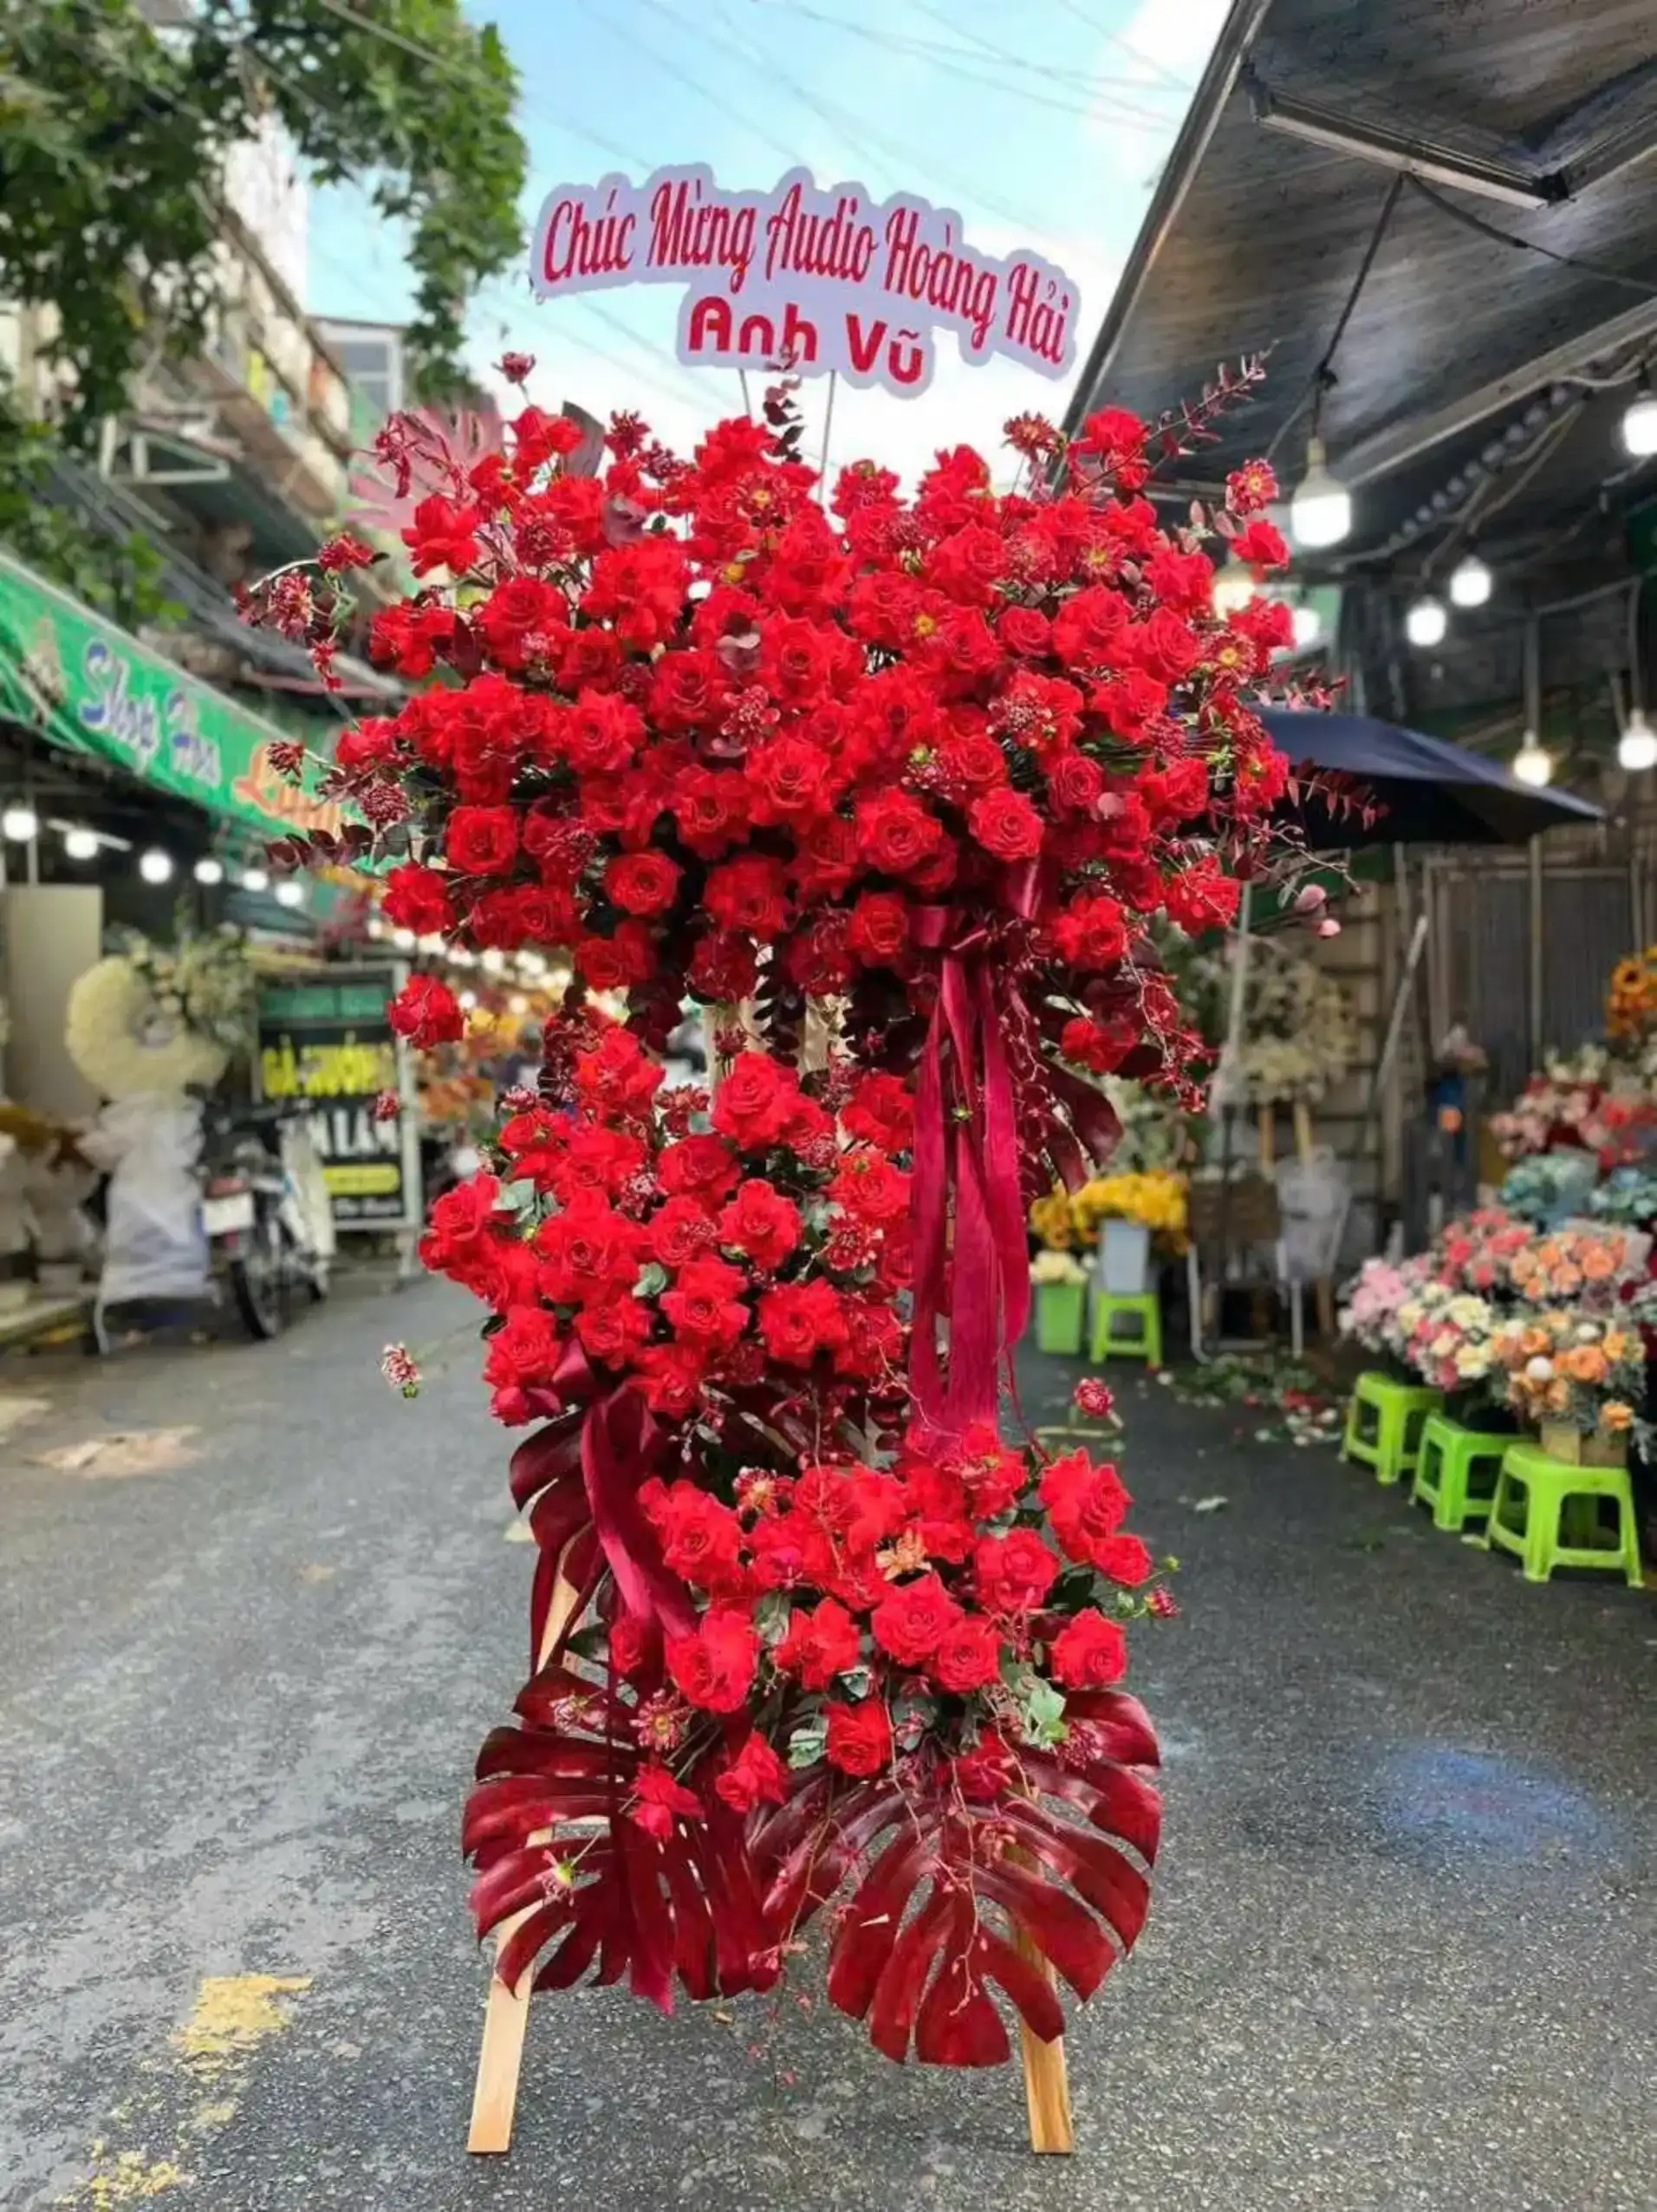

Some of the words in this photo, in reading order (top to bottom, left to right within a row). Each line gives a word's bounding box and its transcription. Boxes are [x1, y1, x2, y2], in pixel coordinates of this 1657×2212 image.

[543, 190, 635, 282] Chúc
[646, 179, 757, 294] Mừng
[764, 182, 877, 283] Audio
[884, 207, 997, 350] Hoàng
[1005, 263, 1069, 364] Hải
[688, 296, 818, 361] Anh
[845, 313, 924, 384] Vũ
